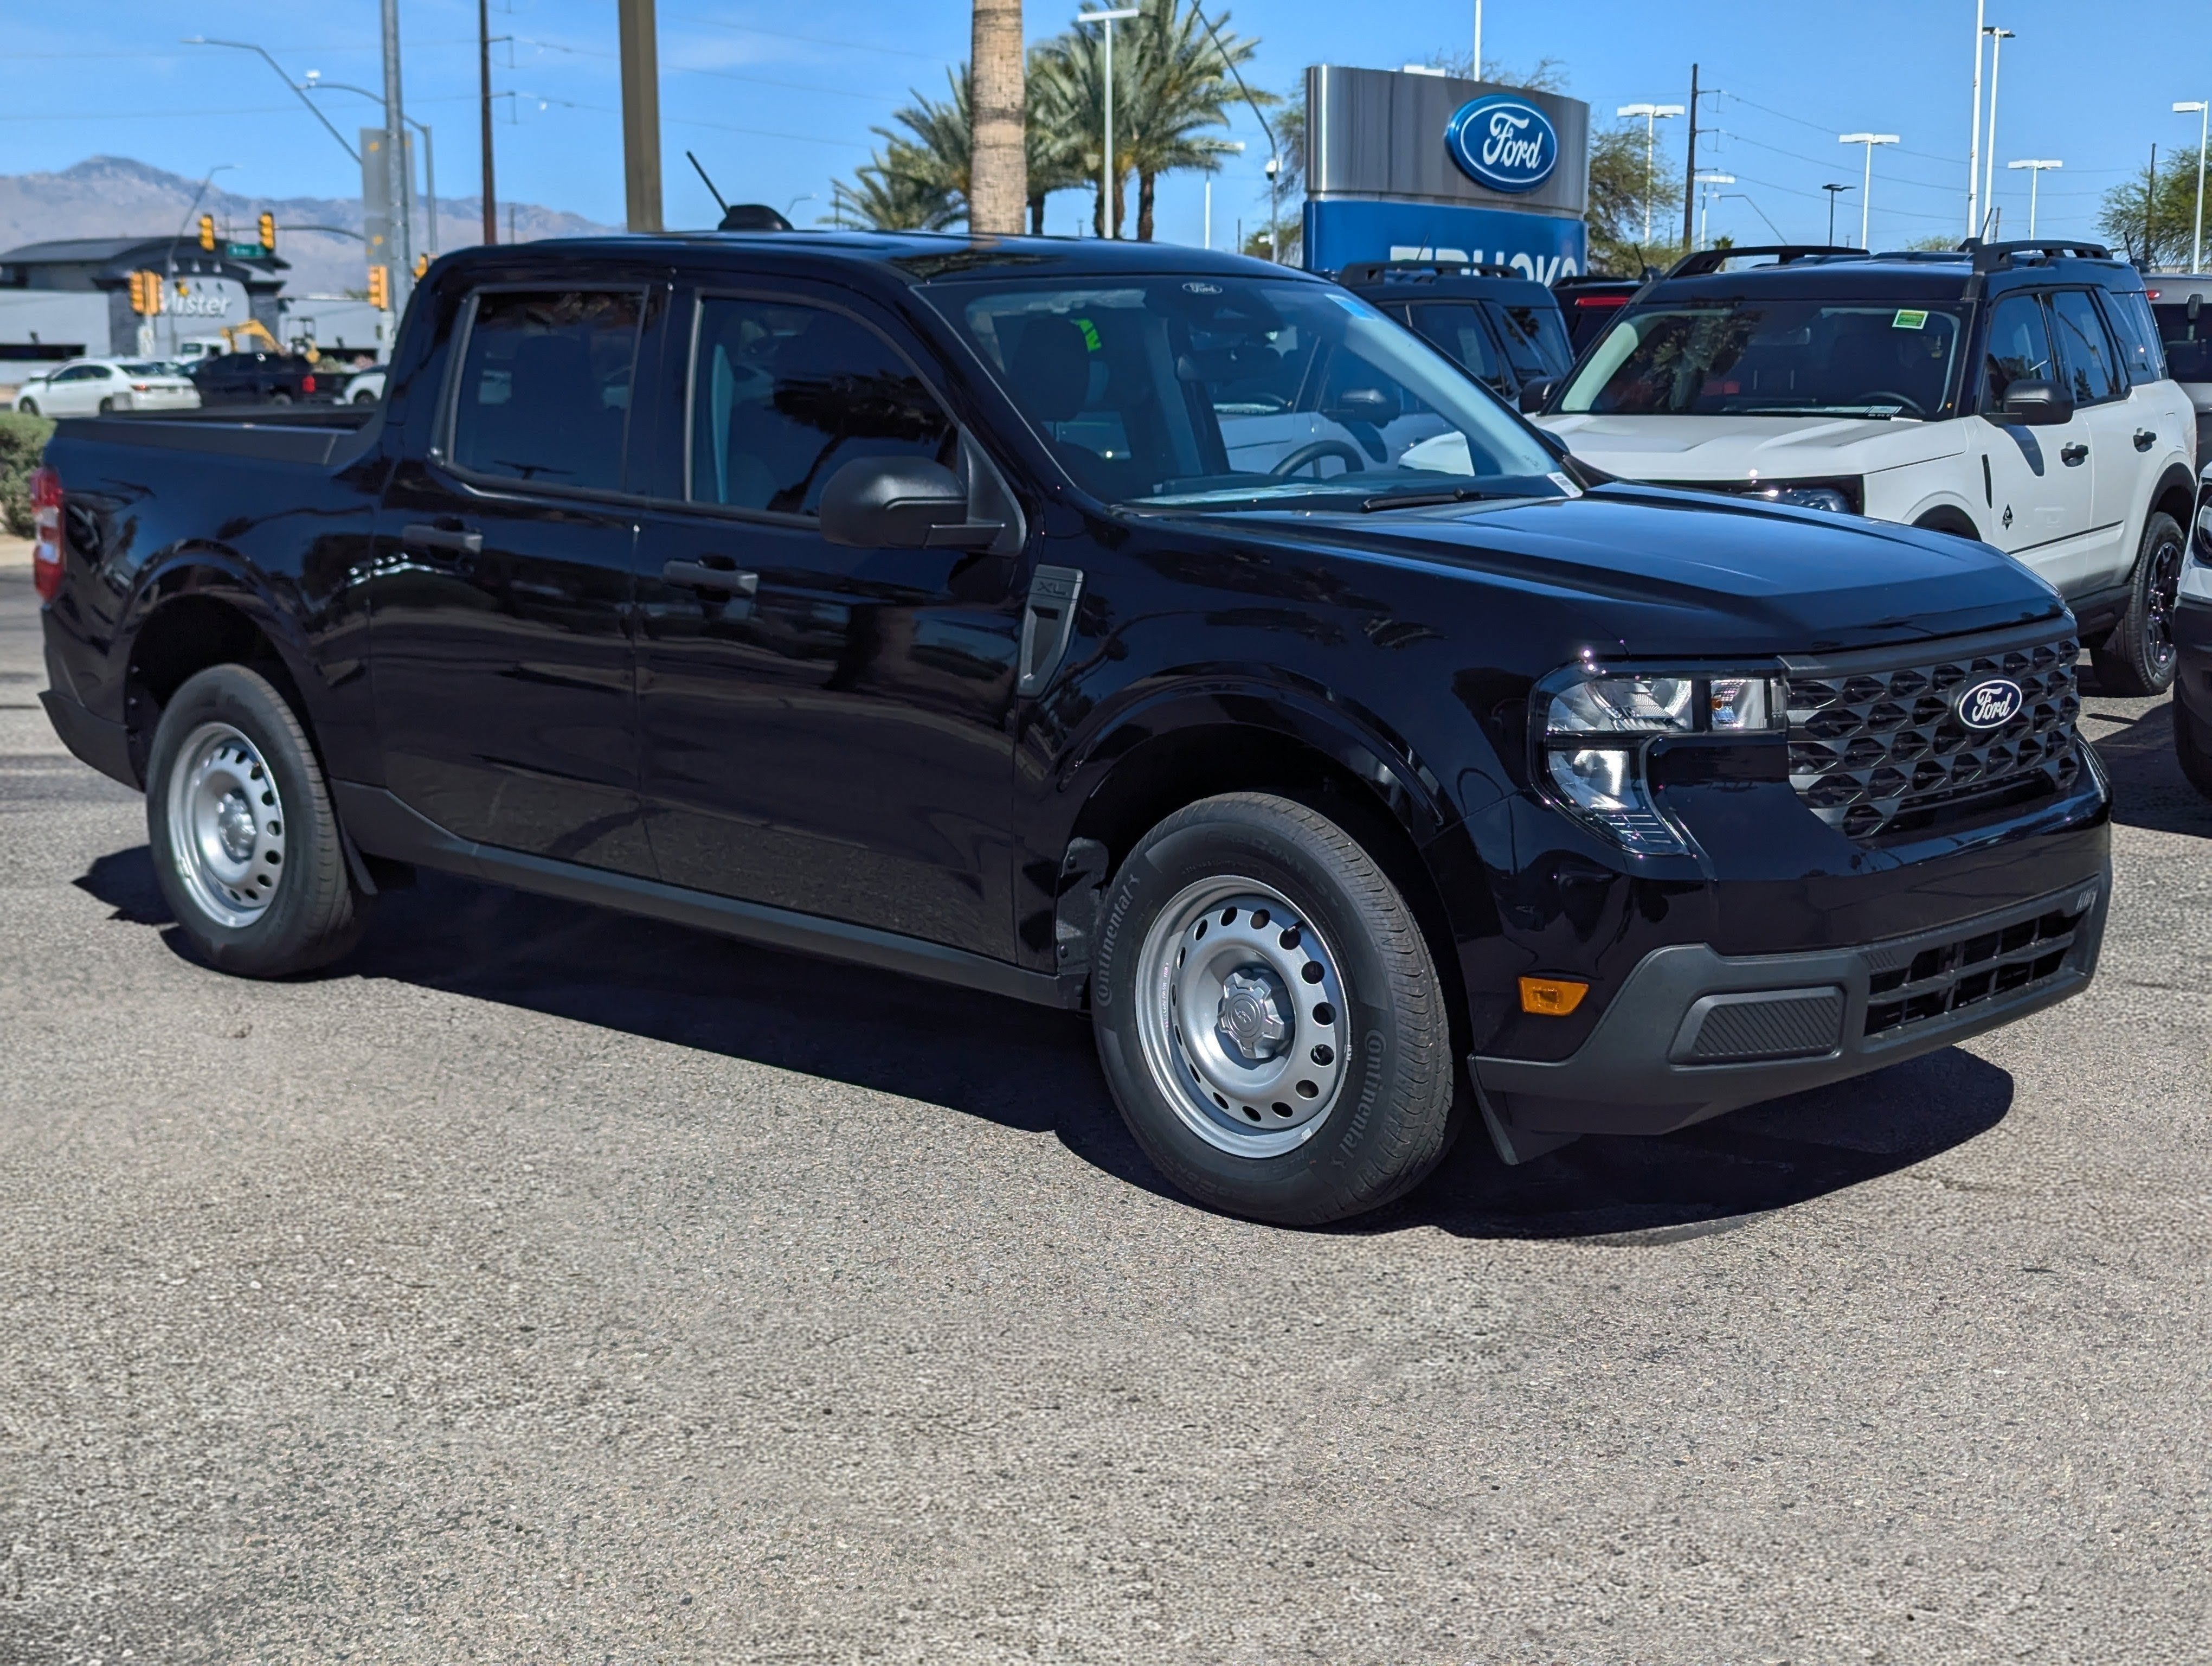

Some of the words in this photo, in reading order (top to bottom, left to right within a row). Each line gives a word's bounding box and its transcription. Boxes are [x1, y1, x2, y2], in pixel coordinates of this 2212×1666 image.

[1483, 112, 1543, 169] Ford
[1972, 687, 2012, 722] Ford
[1096, 885, 1134, 1007] Continental
[1340, 1030, 1387, 1158] Continental
